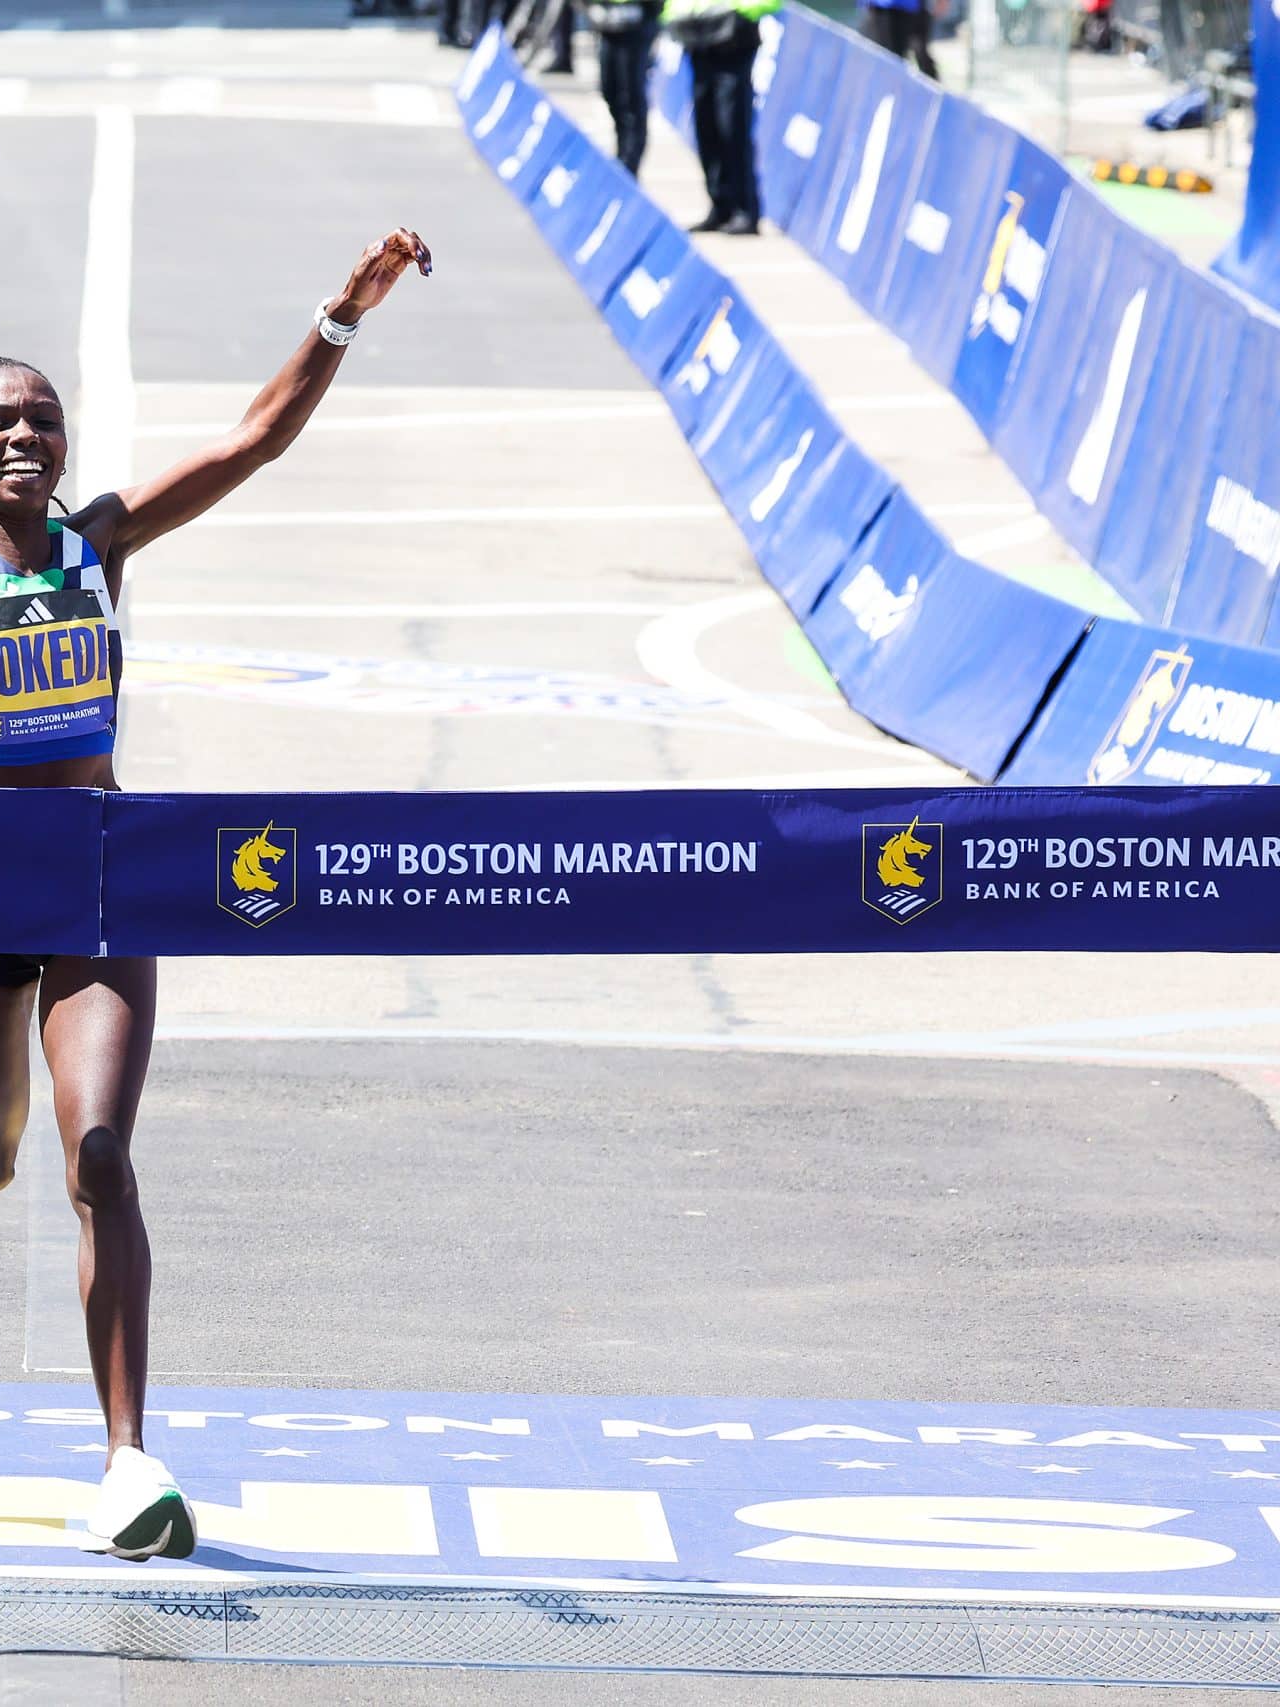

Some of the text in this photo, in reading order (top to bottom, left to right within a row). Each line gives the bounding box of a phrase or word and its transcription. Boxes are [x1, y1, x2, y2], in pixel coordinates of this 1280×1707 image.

[27, 712, 61, 727] BOSTON
[62, 704, 101, 720] MARATHON
[10, 727, 29, 736] BANK
[39, 722, 69, 732] AMERICA
[316, 842, 756, 874] 129TH BOSTON MARATHON
[962, 837, 1280, 868] 129TH BOSTON MAR
[320, 888, 570, 905] BANK OF AMERICA
[967, 881, 1219, 899] BANK OF AMERICA
[601, 1418, 1280, 1453] MARAT
